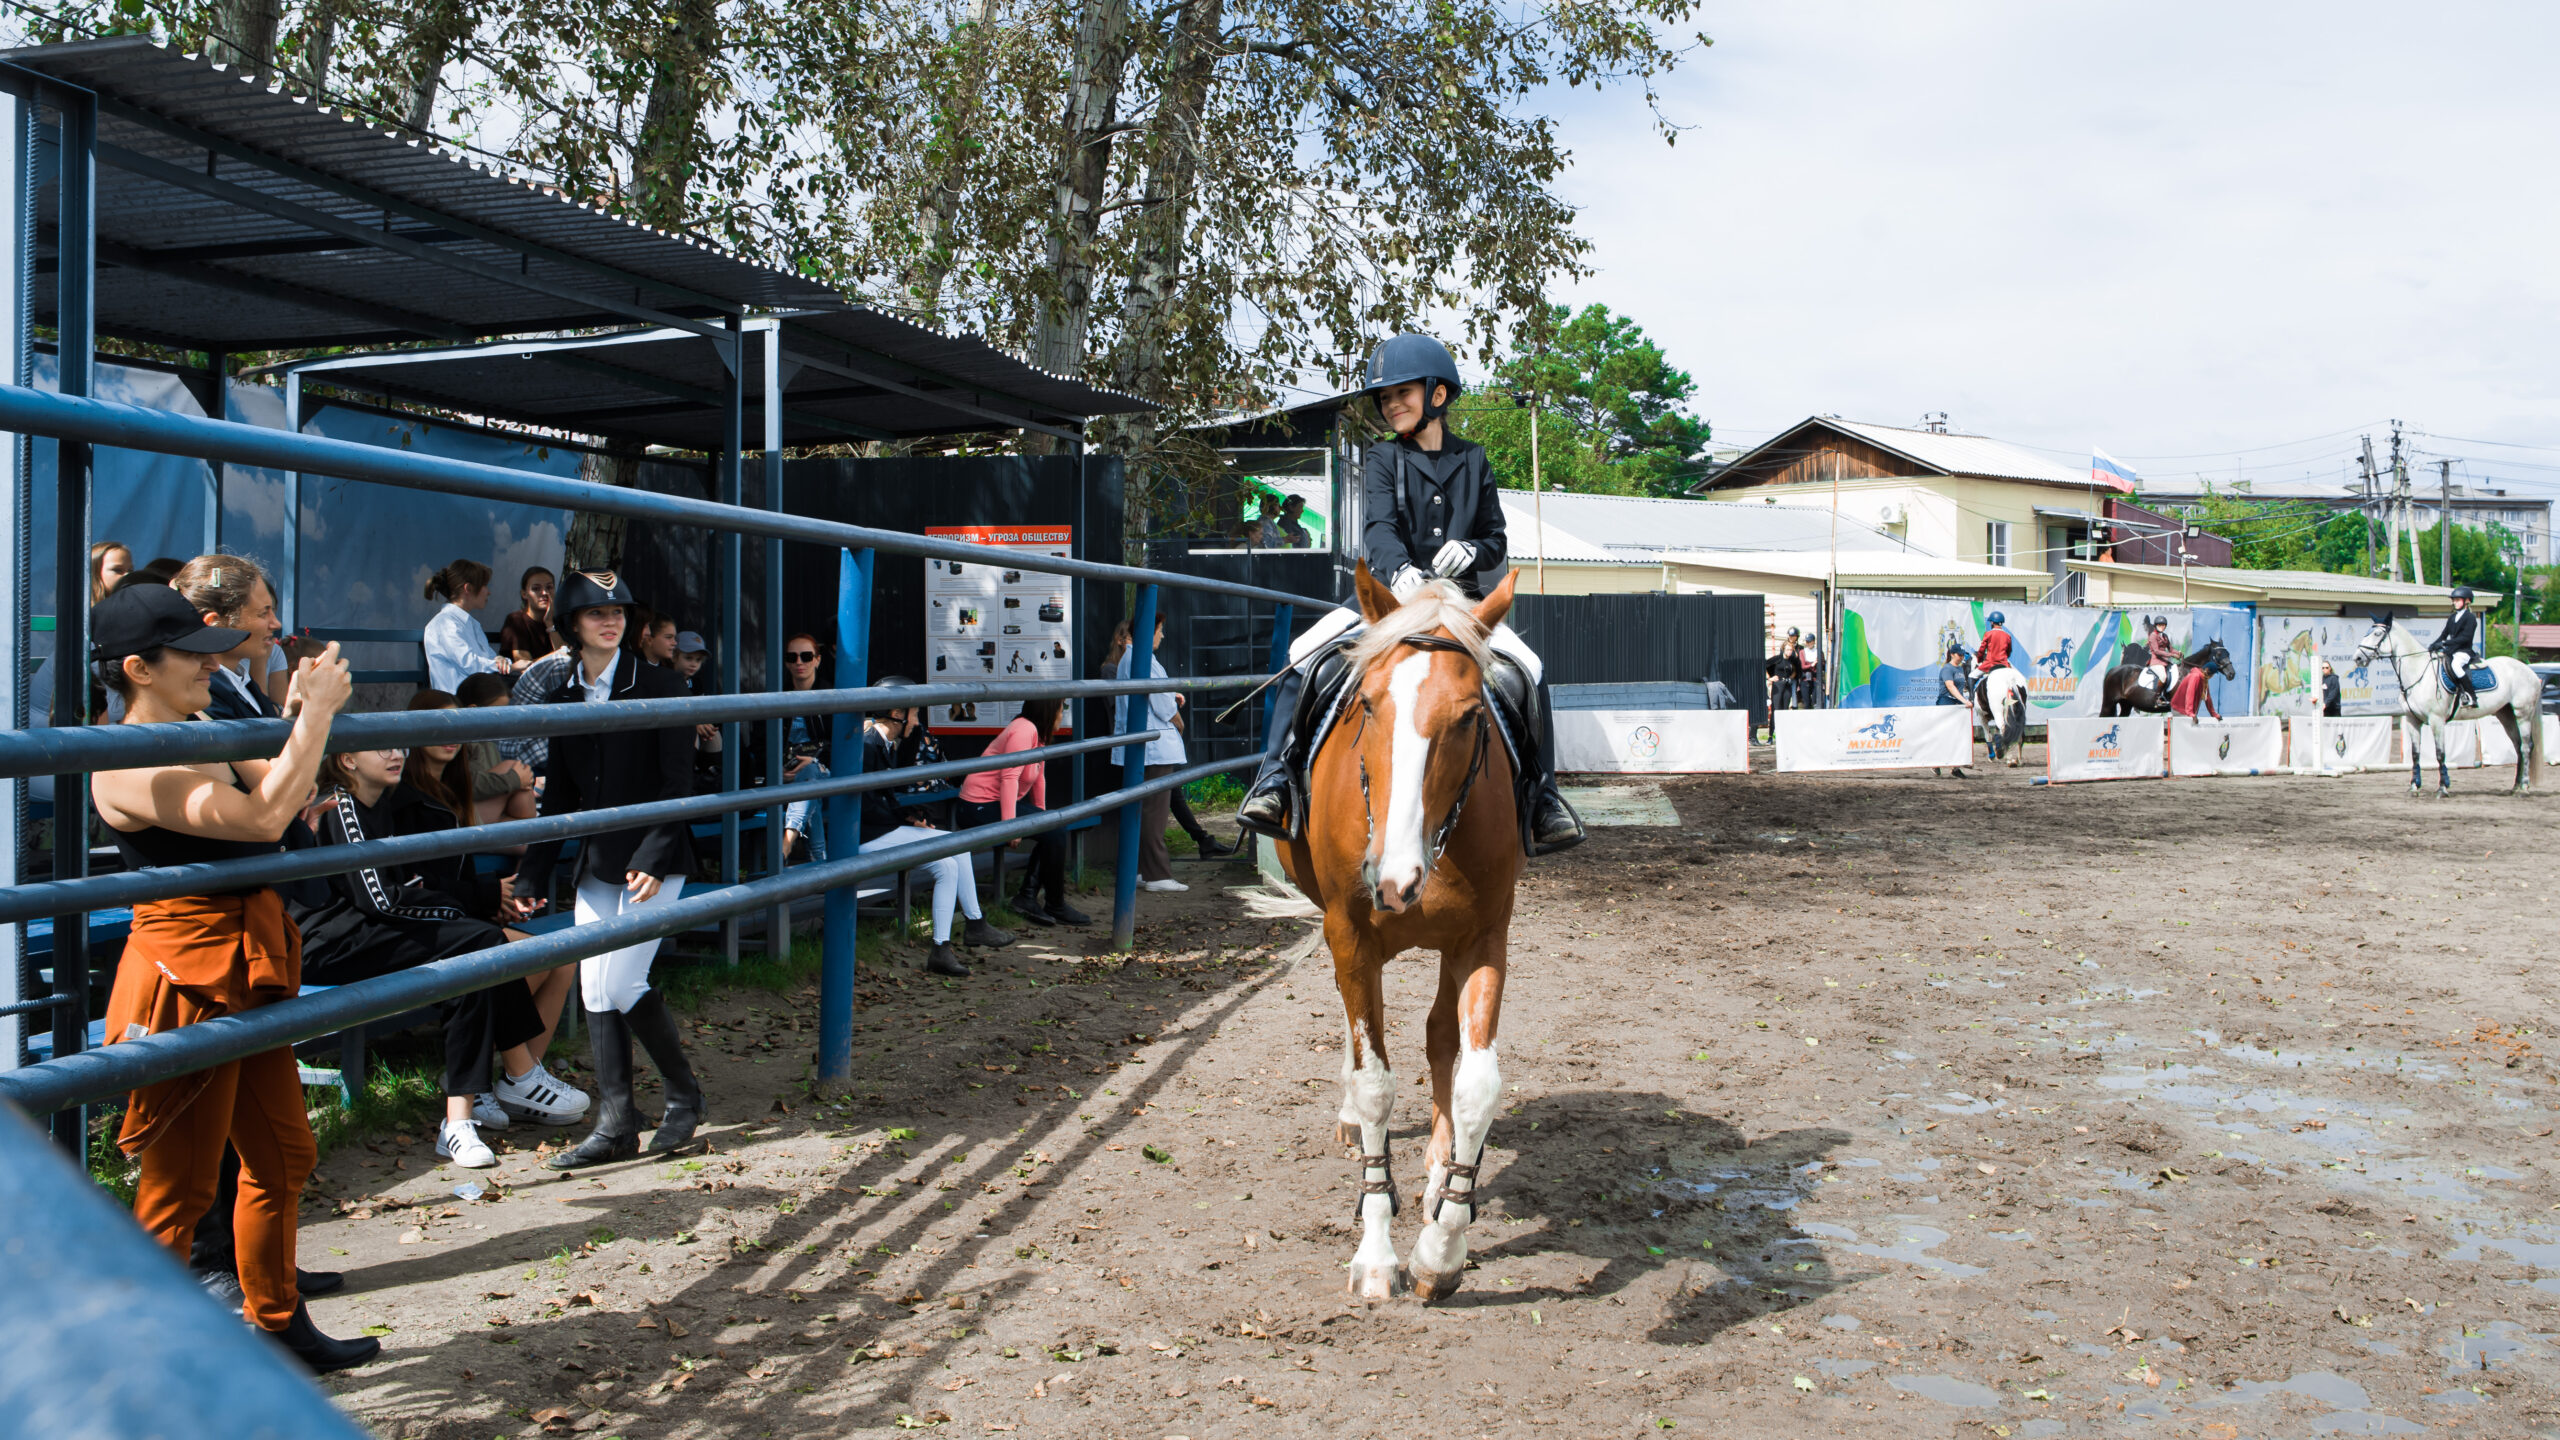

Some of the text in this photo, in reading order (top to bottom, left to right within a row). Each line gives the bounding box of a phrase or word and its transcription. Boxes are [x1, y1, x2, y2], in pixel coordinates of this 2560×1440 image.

[988, 532, 1019, 543] УГРОЗА
[1022, 532, 1070, 543] ОБЩЕСТВУ
[2028, 677, 2079, 692] МУСТАНГ
[1848, 738, 1904, 750] МУСТАНГ
